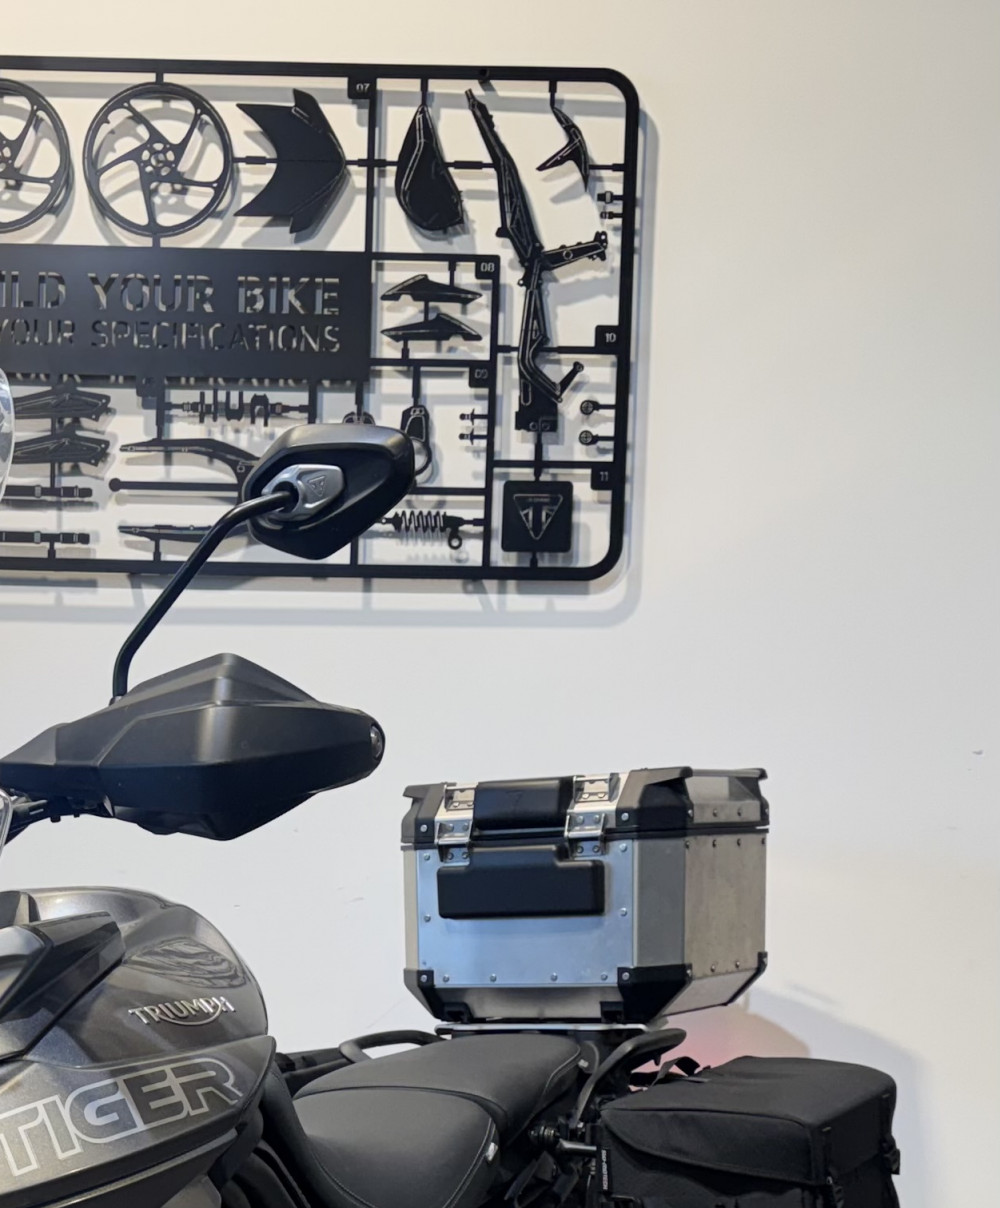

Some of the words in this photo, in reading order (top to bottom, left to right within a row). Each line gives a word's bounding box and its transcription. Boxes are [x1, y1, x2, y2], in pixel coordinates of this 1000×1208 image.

[356, 83, 370, 92] 07
[480, 262, 495, 272] 08
[87, 272, 214, 312] YOUR
[237, 275, 339, 315] BIKE
[91, 319, 340, 352] SPECIFICATIONS
[605, 332, 616, 343] 10
[128, 996, 236, 1025] TRIUMPH
